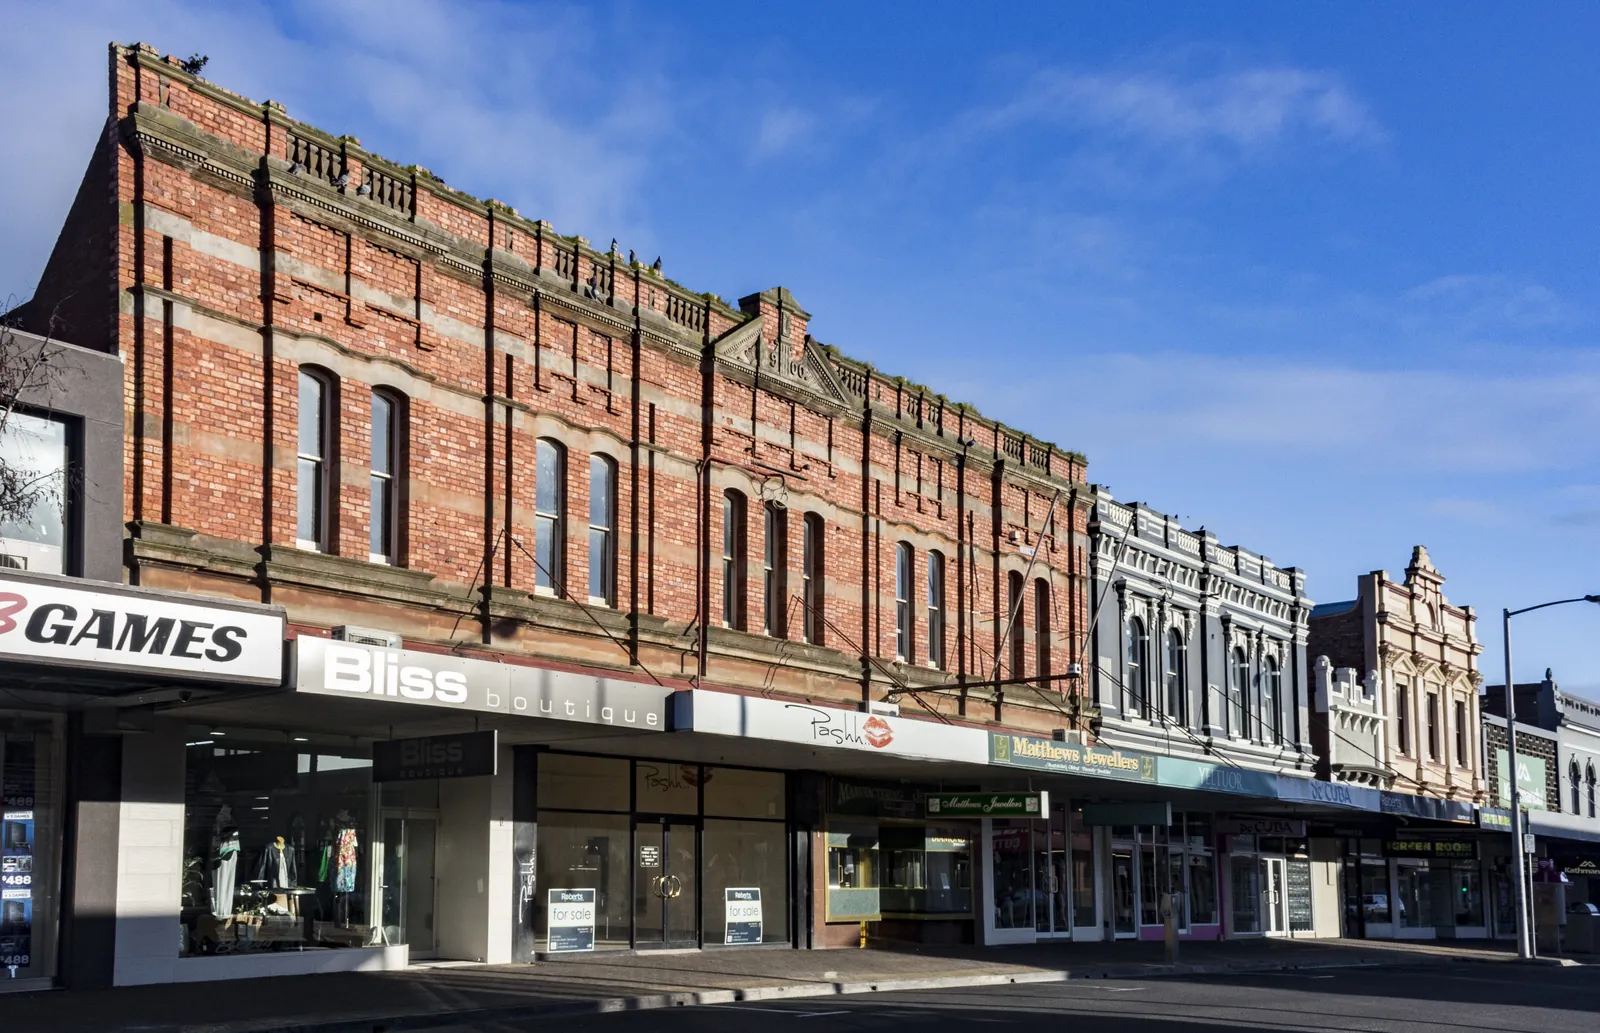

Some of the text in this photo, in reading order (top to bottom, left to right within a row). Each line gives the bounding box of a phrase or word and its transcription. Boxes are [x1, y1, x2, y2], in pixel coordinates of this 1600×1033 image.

[25, 603, 247, 662] GAMES
[323, 645, 658, 726] Bliss boutique
[400, 738, 464, 767] Bliss
[1012, 736, 1080, 763] Matthews
[1083, 746, 1139, 772] Jewellers
[399, 765, 464, 778] boutique
[1324, 782, 1352, 804] CUBA
[941, 796, 1023, 813] Matthews Jewellers
[1254, 821, 1293, 833] CUBA
[2, 875, 32, 886] $488
[561, 892, 584, 901] Roberts
[553, 907, 592, 921] for sale
[729, 905, 759, 917] for sale
[0, 955, 29, 965] $488
